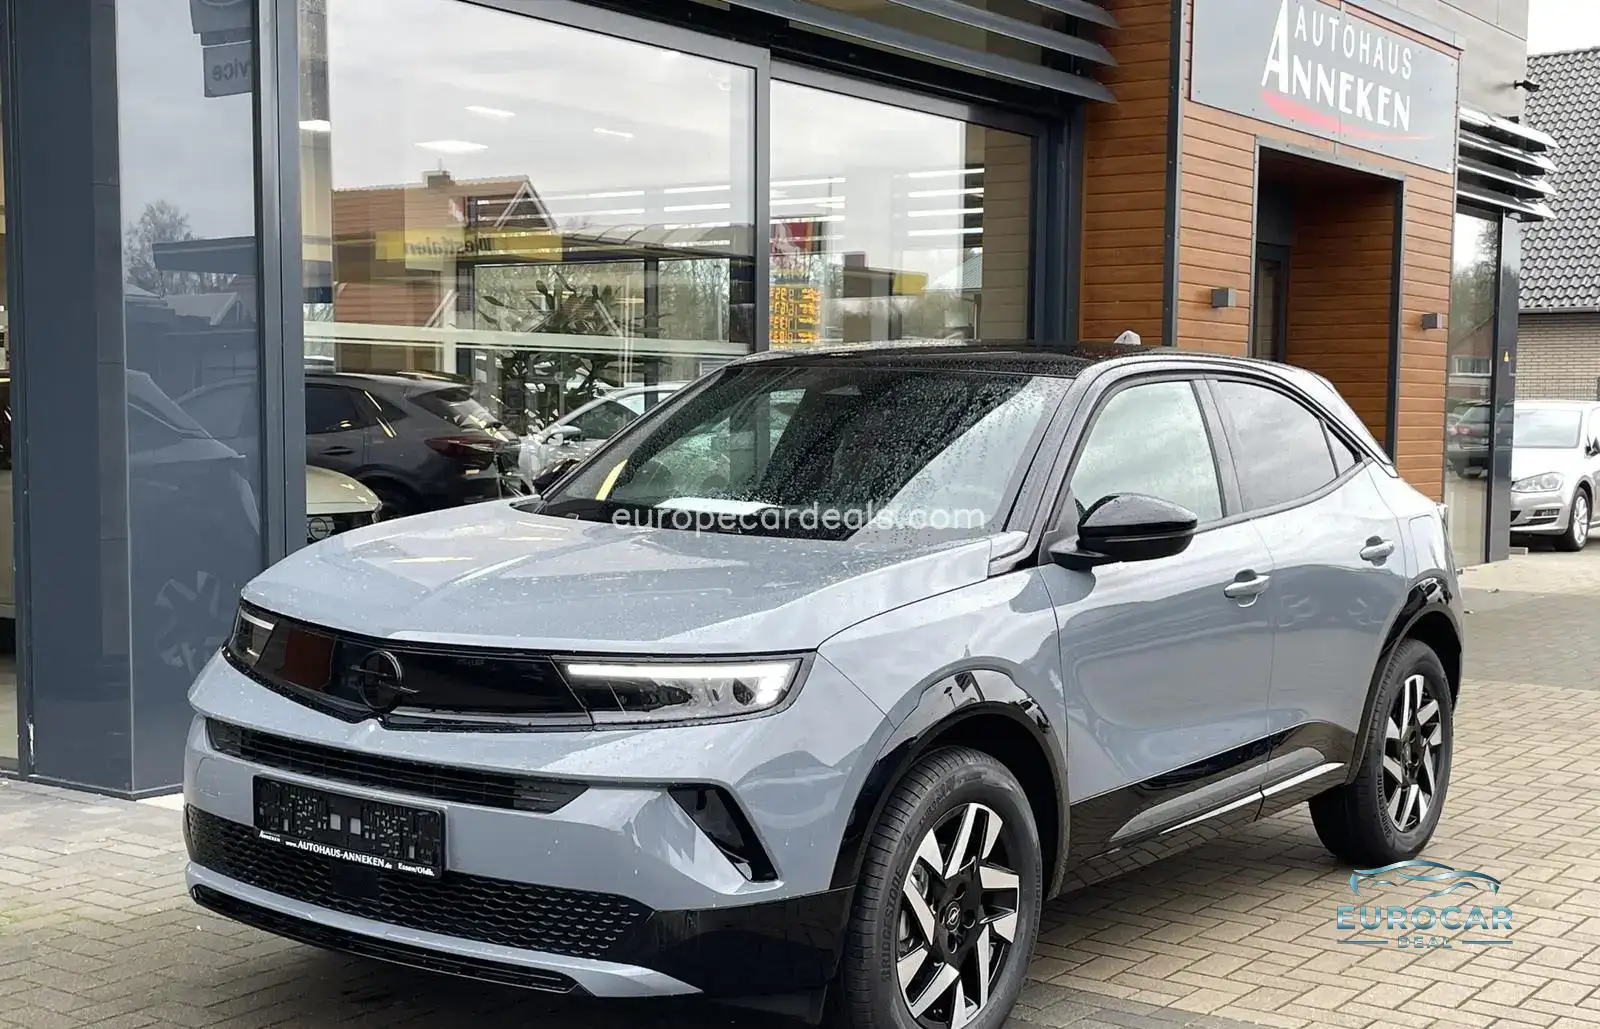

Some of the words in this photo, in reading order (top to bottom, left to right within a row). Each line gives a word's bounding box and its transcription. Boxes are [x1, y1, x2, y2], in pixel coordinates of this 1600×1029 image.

[1261, 0, 1411, 131] ANNEKEN
[1294, 6, 1412, 80] AUTOHAUS
[879, 867, 902, 983] BRIDGESTONE
